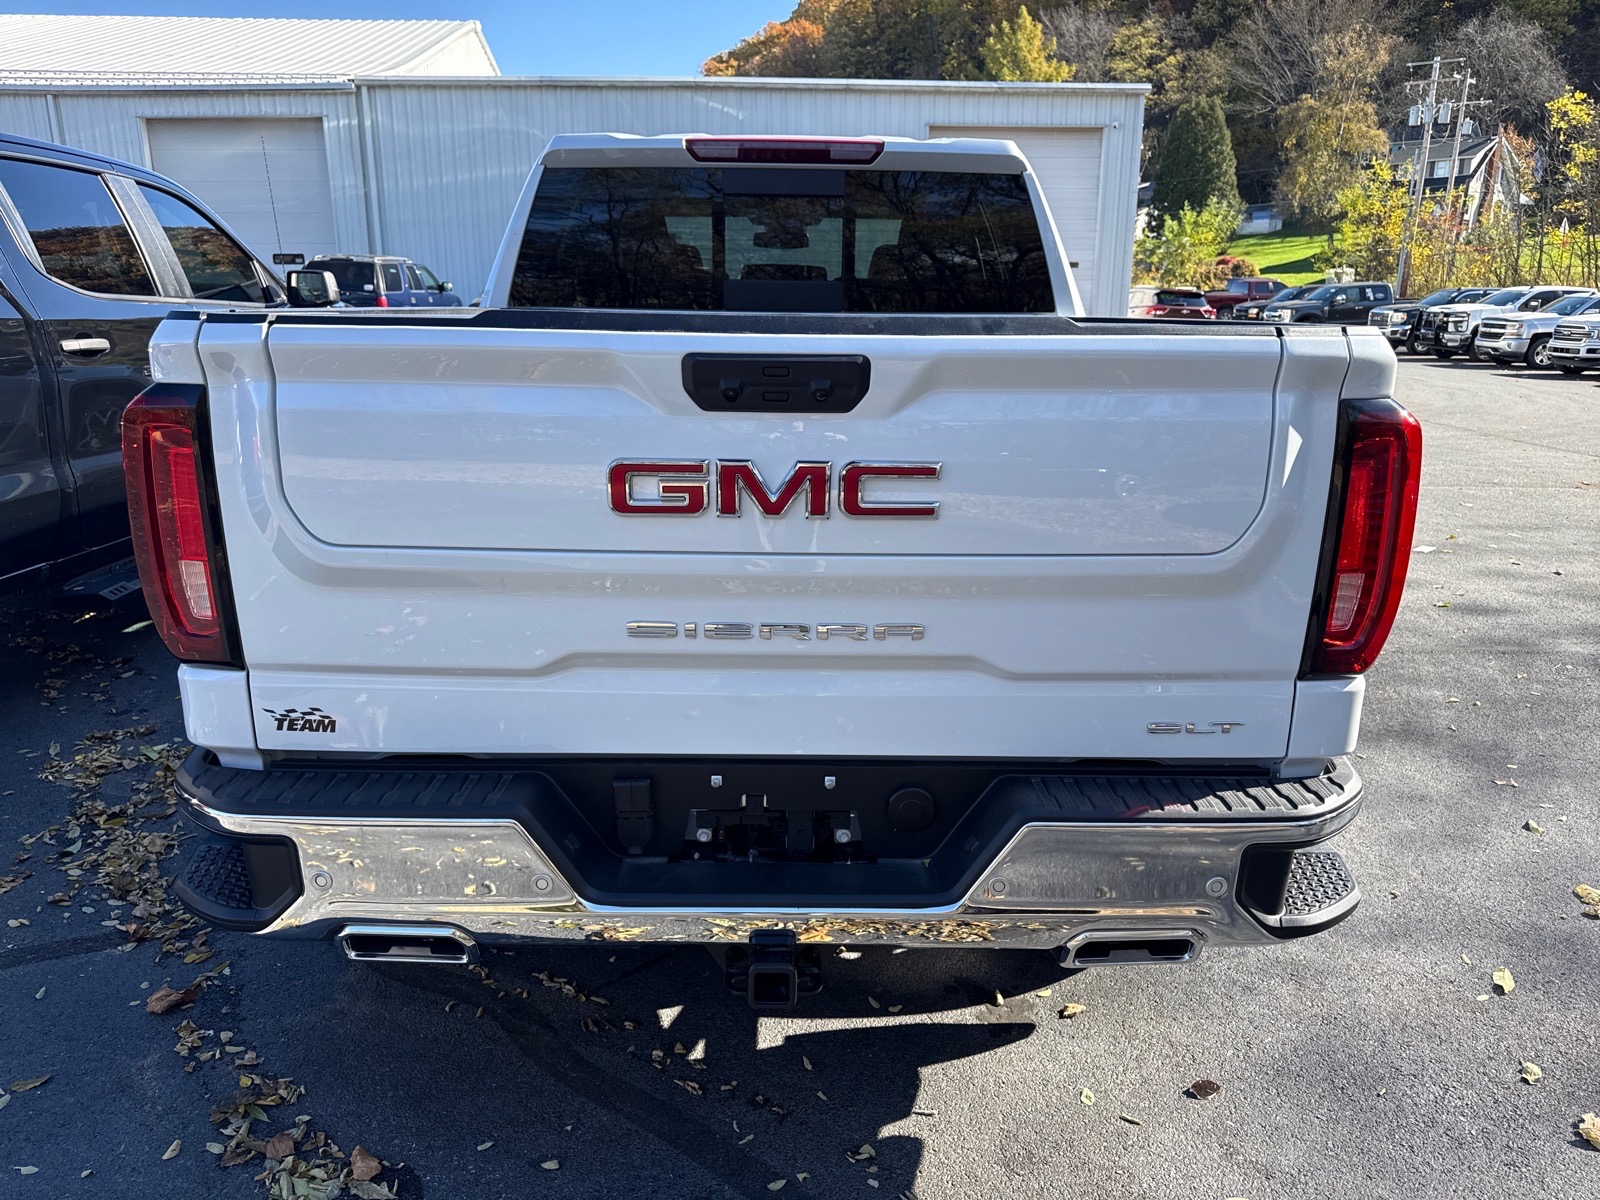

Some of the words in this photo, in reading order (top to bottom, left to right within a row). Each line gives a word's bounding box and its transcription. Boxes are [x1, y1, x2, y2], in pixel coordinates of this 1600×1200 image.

[607, 458, 943, 520] GMC
[626, 620, 926, 641] SIERRA
[274, 717, 337, 733] TEAM
[1147, 721, 1245, 734] SLT
